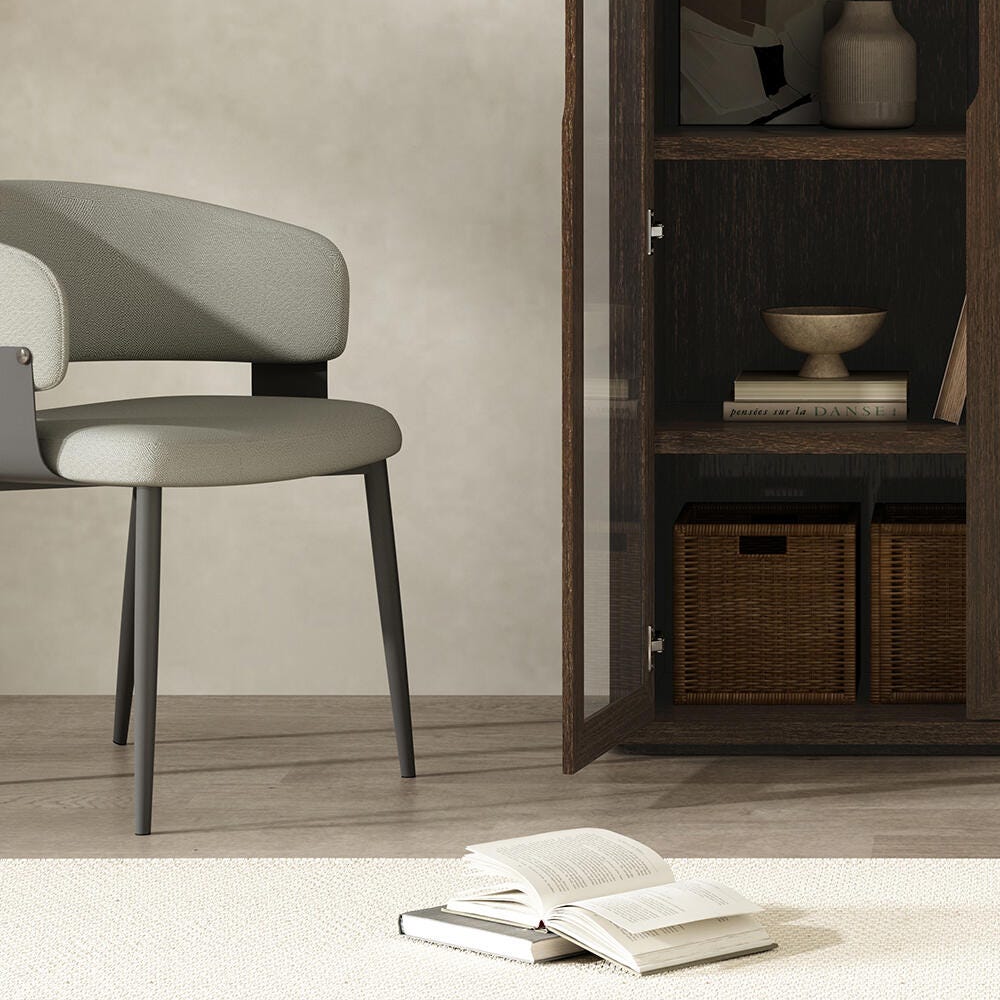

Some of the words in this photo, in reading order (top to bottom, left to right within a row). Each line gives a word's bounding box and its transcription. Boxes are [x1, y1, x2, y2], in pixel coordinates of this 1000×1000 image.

[729, 408, 768, 417] pensées
[772, 408, 790, 417] sur
[794, 406, 807, 417] la
[814, 406, 886, 417] DANSE
